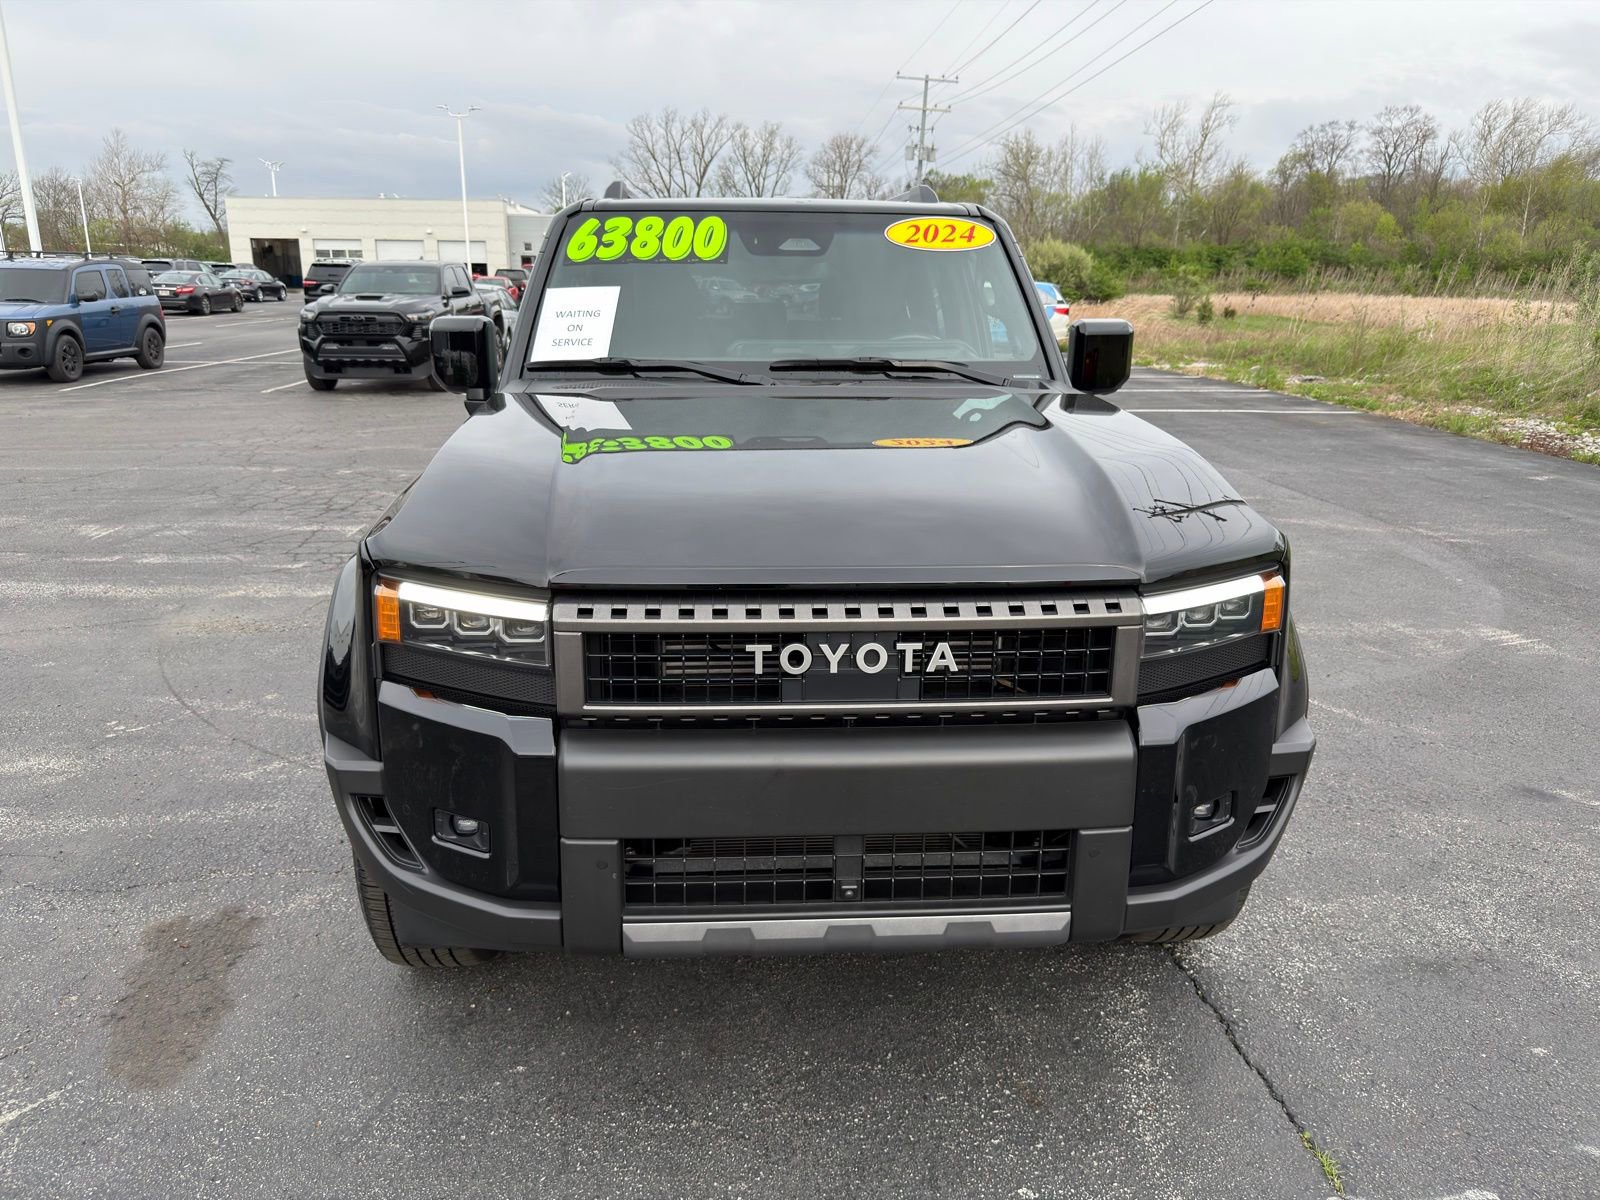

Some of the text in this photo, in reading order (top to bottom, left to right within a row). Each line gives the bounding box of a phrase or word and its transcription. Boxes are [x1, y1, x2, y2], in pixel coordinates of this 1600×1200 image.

[566, 216, 727, 262] 63800
[905, 224, 976, 243] 2024
[555, 310, 601, 319] WAITING
[567, 324, 583, 332] ON
[551, 337, 593, 347] SERVICE
[745, 642, 959, 676] TOYOTA
